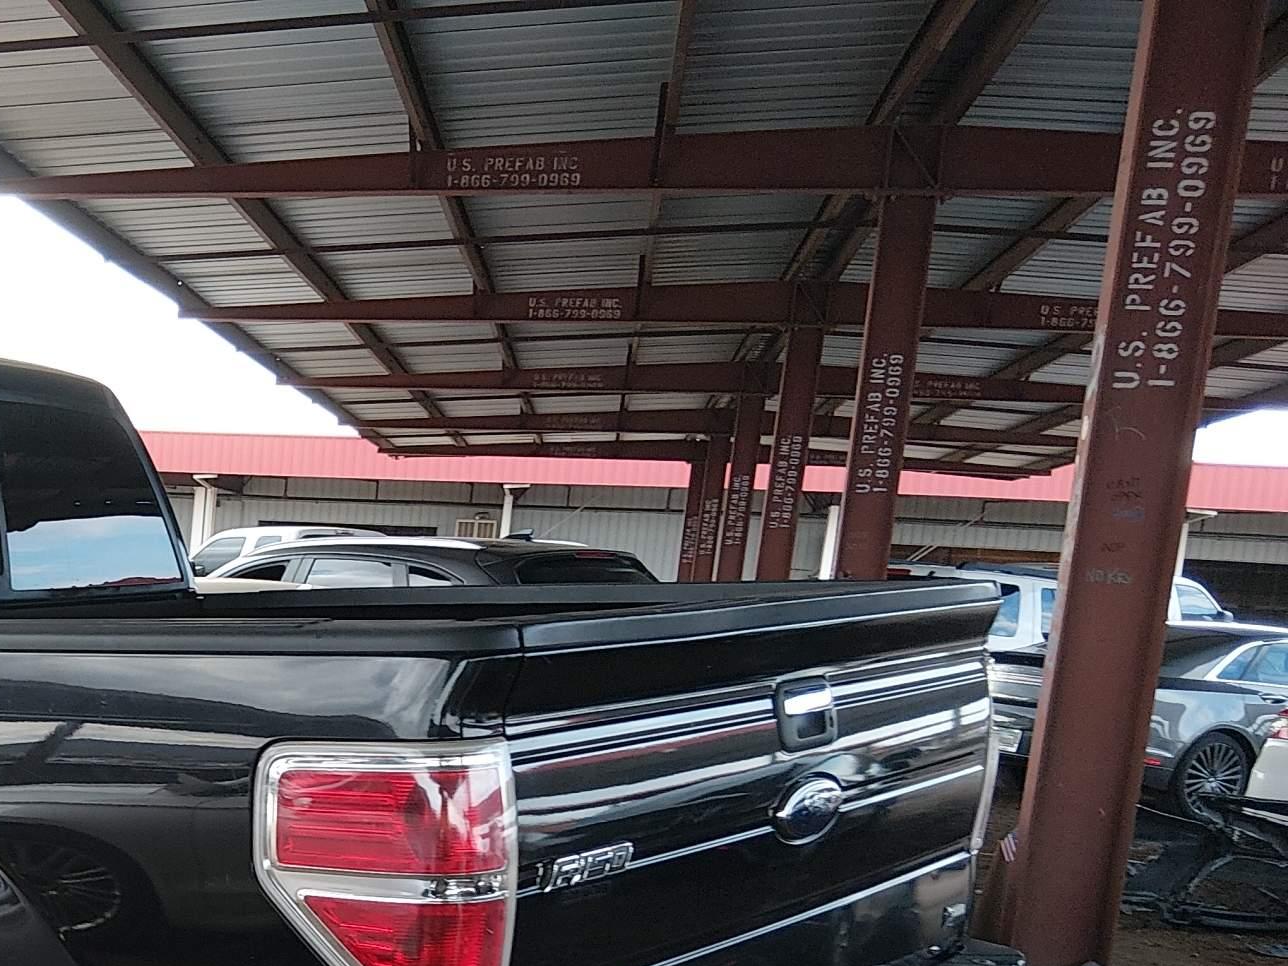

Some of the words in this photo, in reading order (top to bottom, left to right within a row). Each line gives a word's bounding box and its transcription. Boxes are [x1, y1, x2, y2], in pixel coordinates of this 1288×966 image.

[484, 157, 545, 171] PREFAB
[1147, 108, 1183, 168] INC.
[1125, 187, 1169, 310] PREFAB
[1147, 111, 1216, 386] 1-866-799-0969
[554, 298, 597, 308] PREFAB
[870, 353, 887, 383] INC.
[1112, 331, 1146, 389] U.S.
[861, 392, 883, 454] PREFAB
[872, 354, 904, 492] 1-866-799-0969
[856, 463, 874, 493] U.S.
